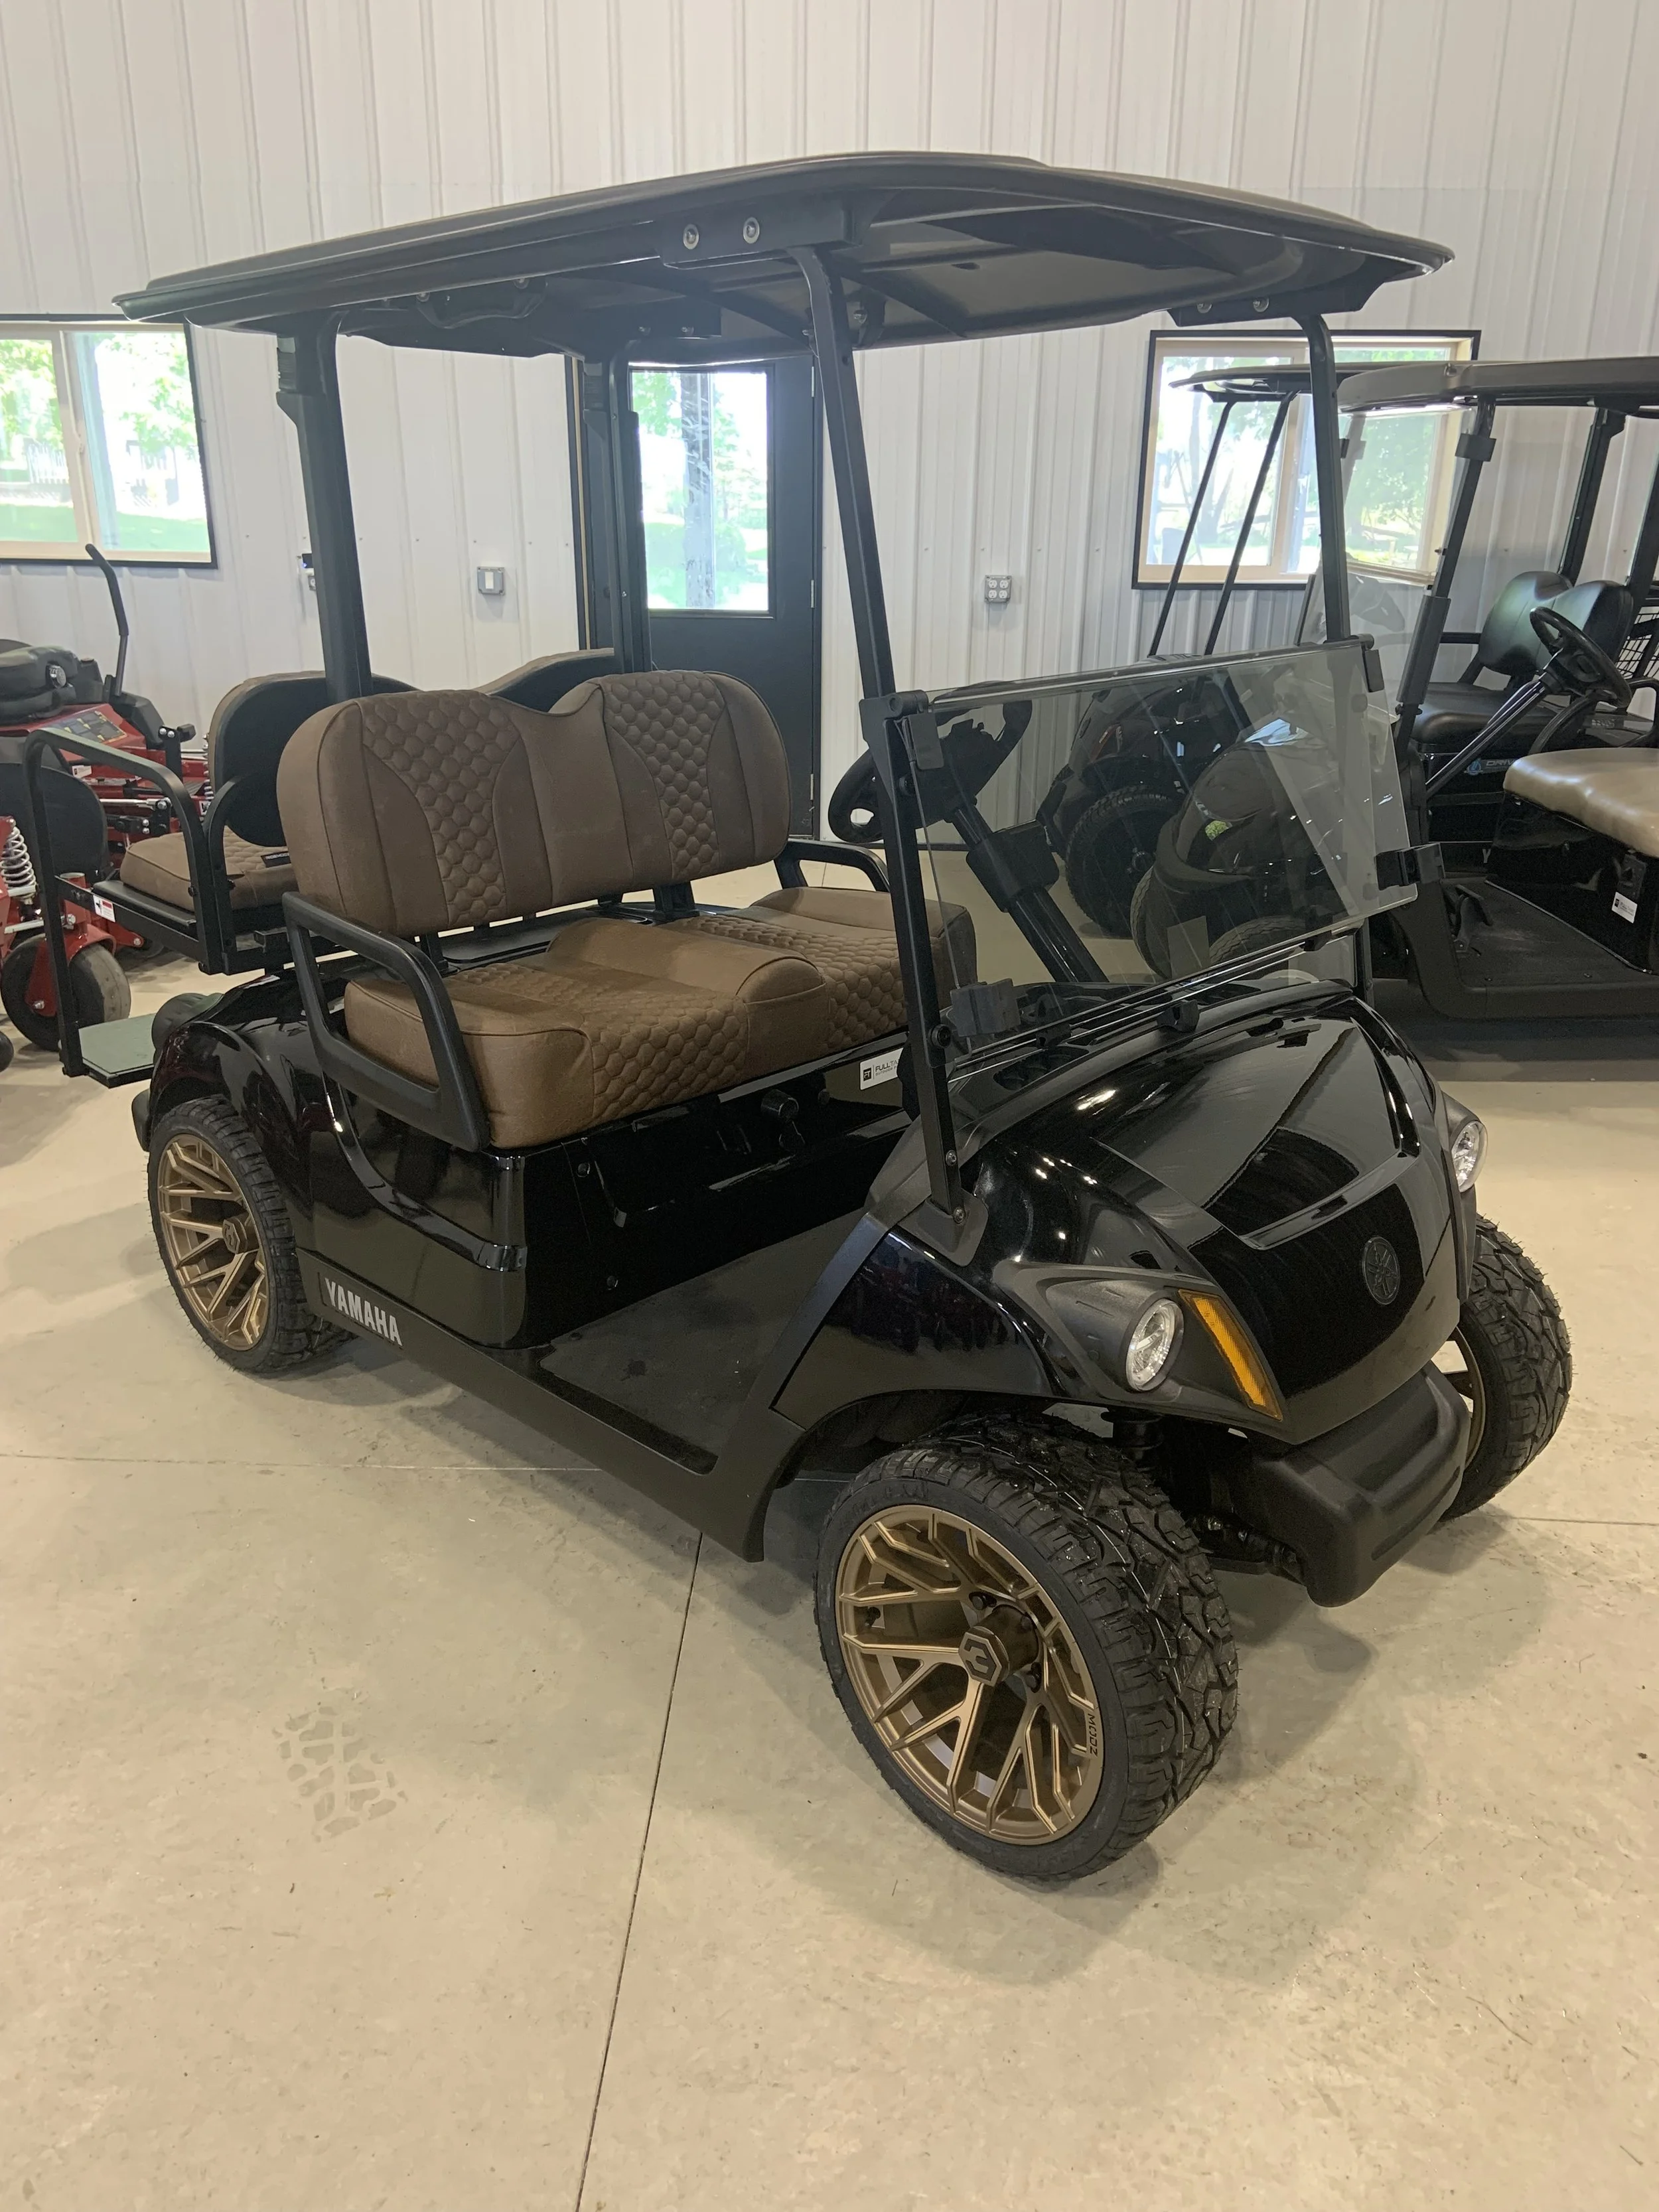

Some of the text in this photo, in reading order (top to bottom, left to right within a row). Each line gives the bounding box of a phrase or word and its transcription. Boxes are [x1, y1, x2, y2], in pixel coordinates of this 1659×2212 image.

[875, 1060, 898, 1072] FULLTA
[325, 1278, 403, 1346] YAMAHA
[1088, 1714, 1098, 1757] MODZ
